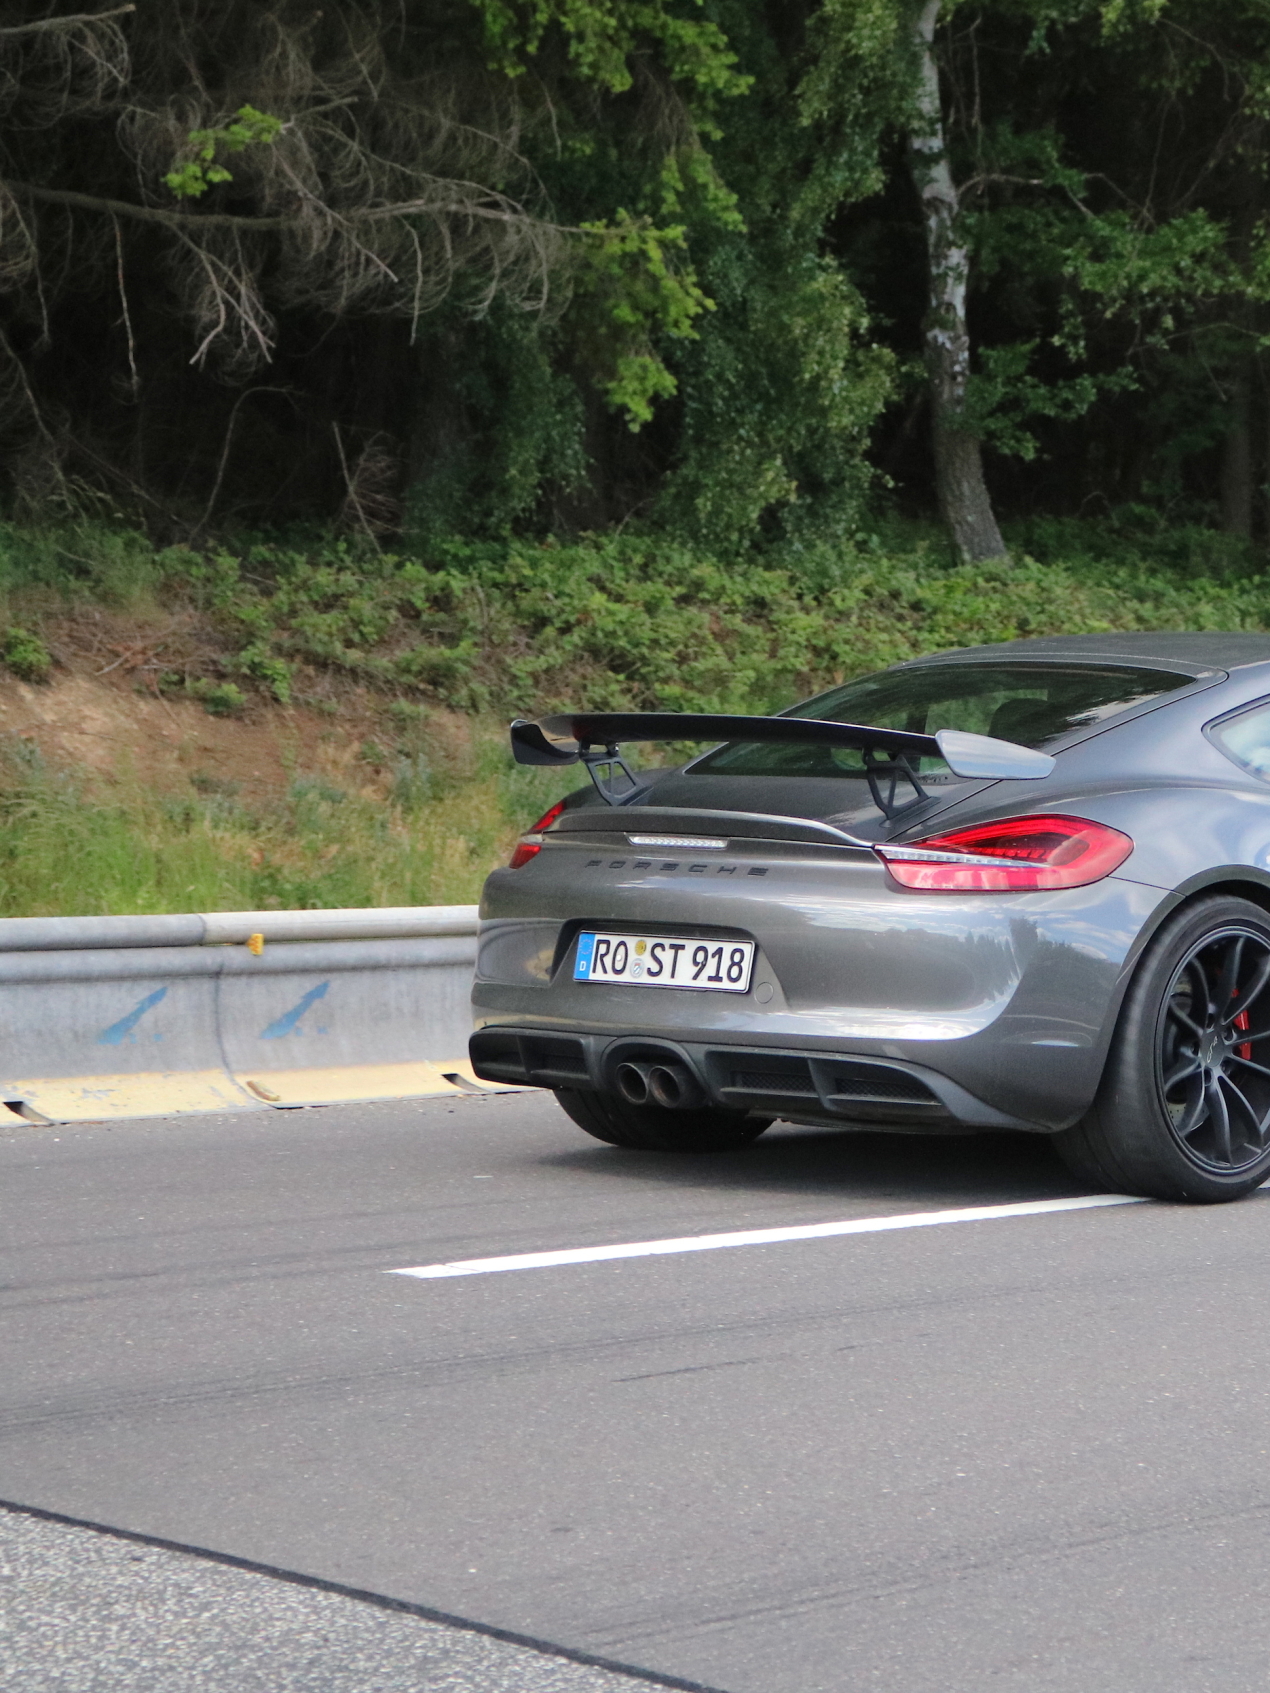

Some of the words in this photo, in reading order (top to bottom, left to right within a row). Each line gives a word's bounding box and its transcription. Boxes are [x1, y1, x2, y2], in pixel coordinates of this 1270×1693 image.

[585, 860, 769, 876] PORSCHE
[579, 960, 587, 971] D
[592, 939, 628, 975] RO
[646, 942, 686, 979] ST
[692, 945, 745, 983] 918
